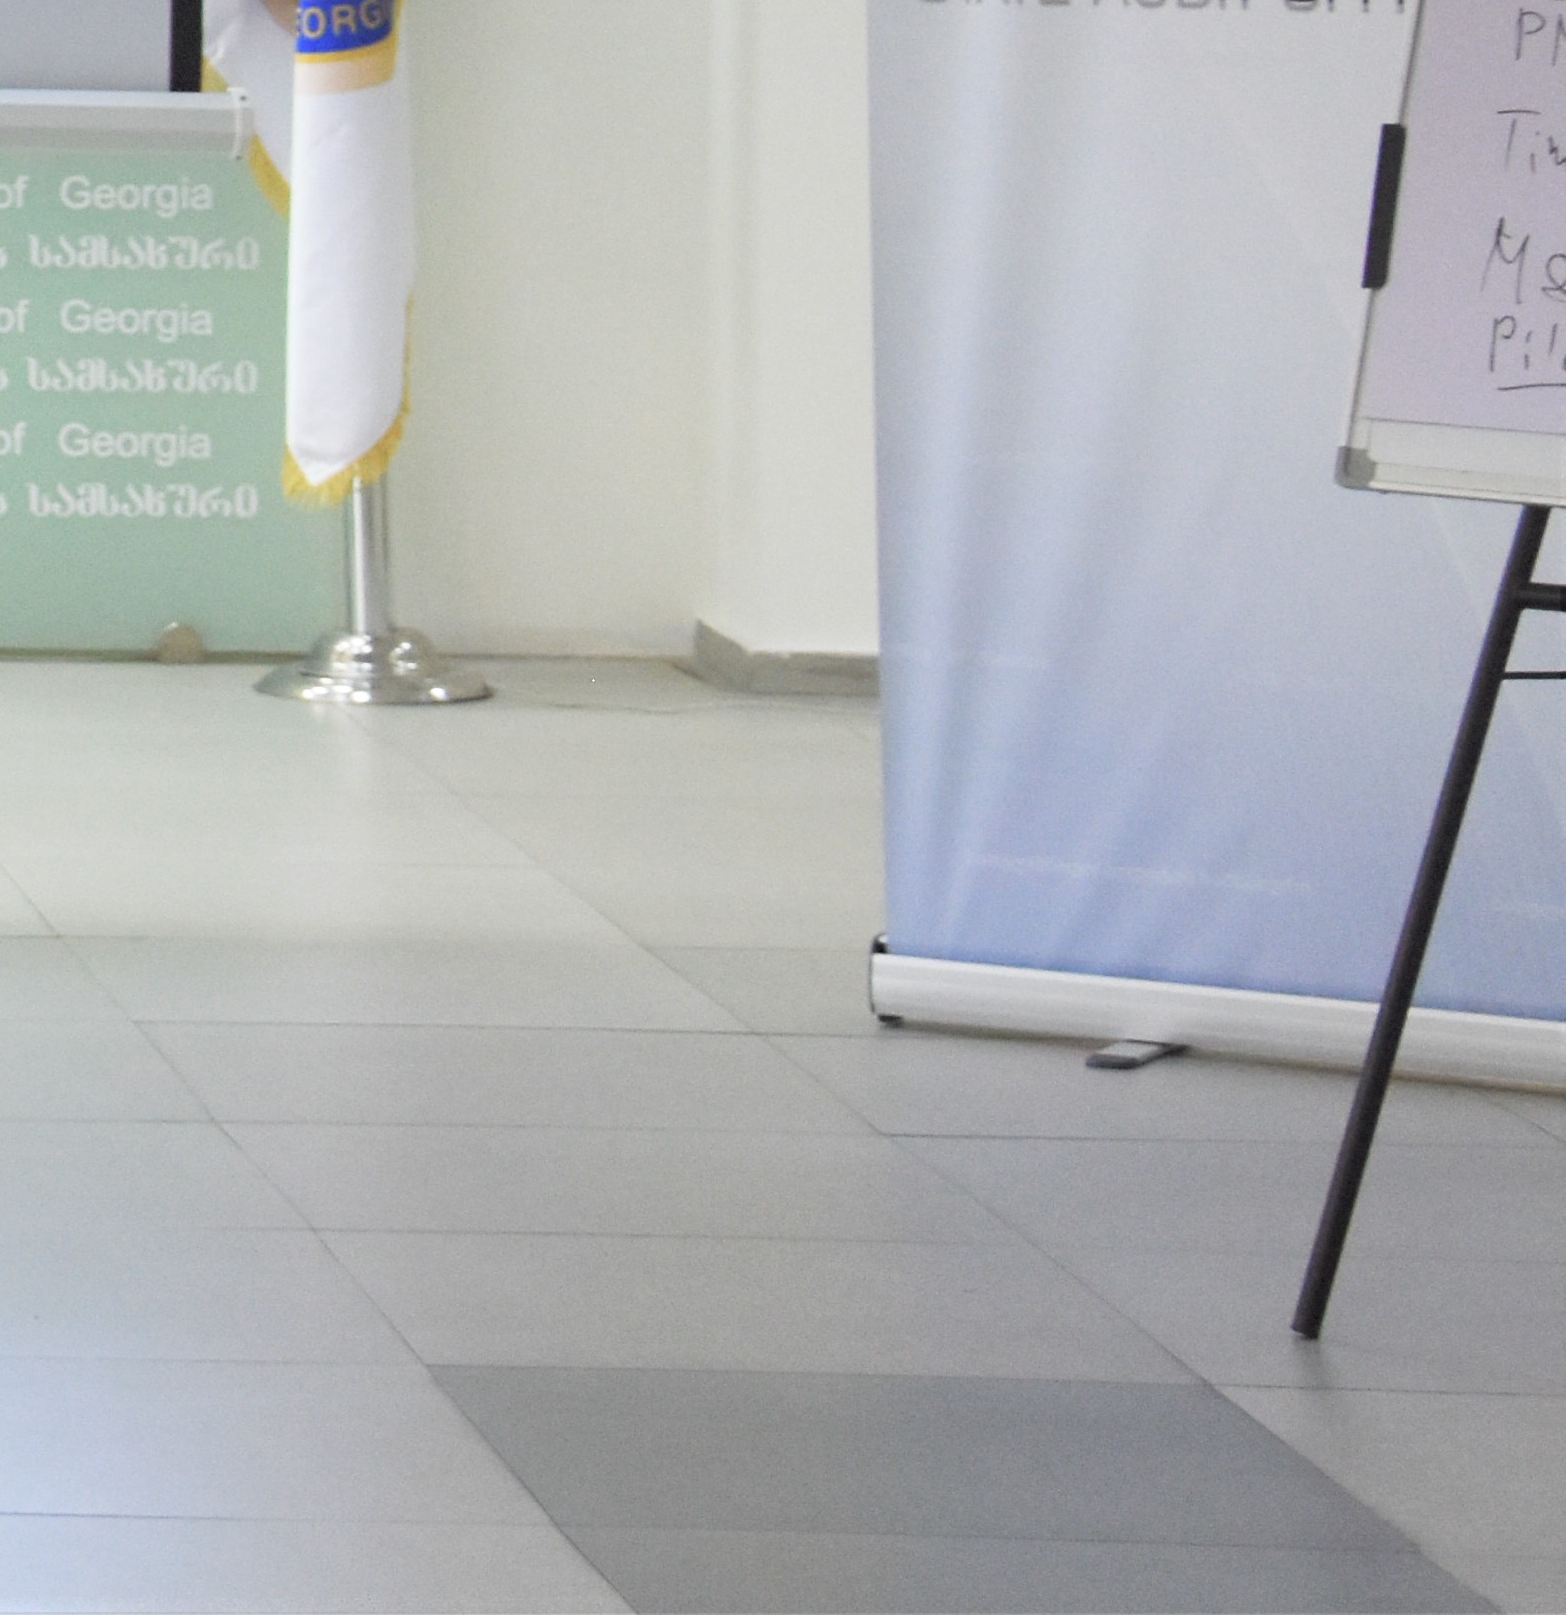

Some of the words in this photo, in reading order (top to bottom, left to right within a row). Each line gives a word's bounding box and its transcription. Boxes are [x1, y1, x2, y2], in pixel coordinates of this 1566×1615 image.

[59, 175, 214, 218] Georgia
[59, 300, 214, 343] Georgia
[59, 423, 214, 466] Georgia
